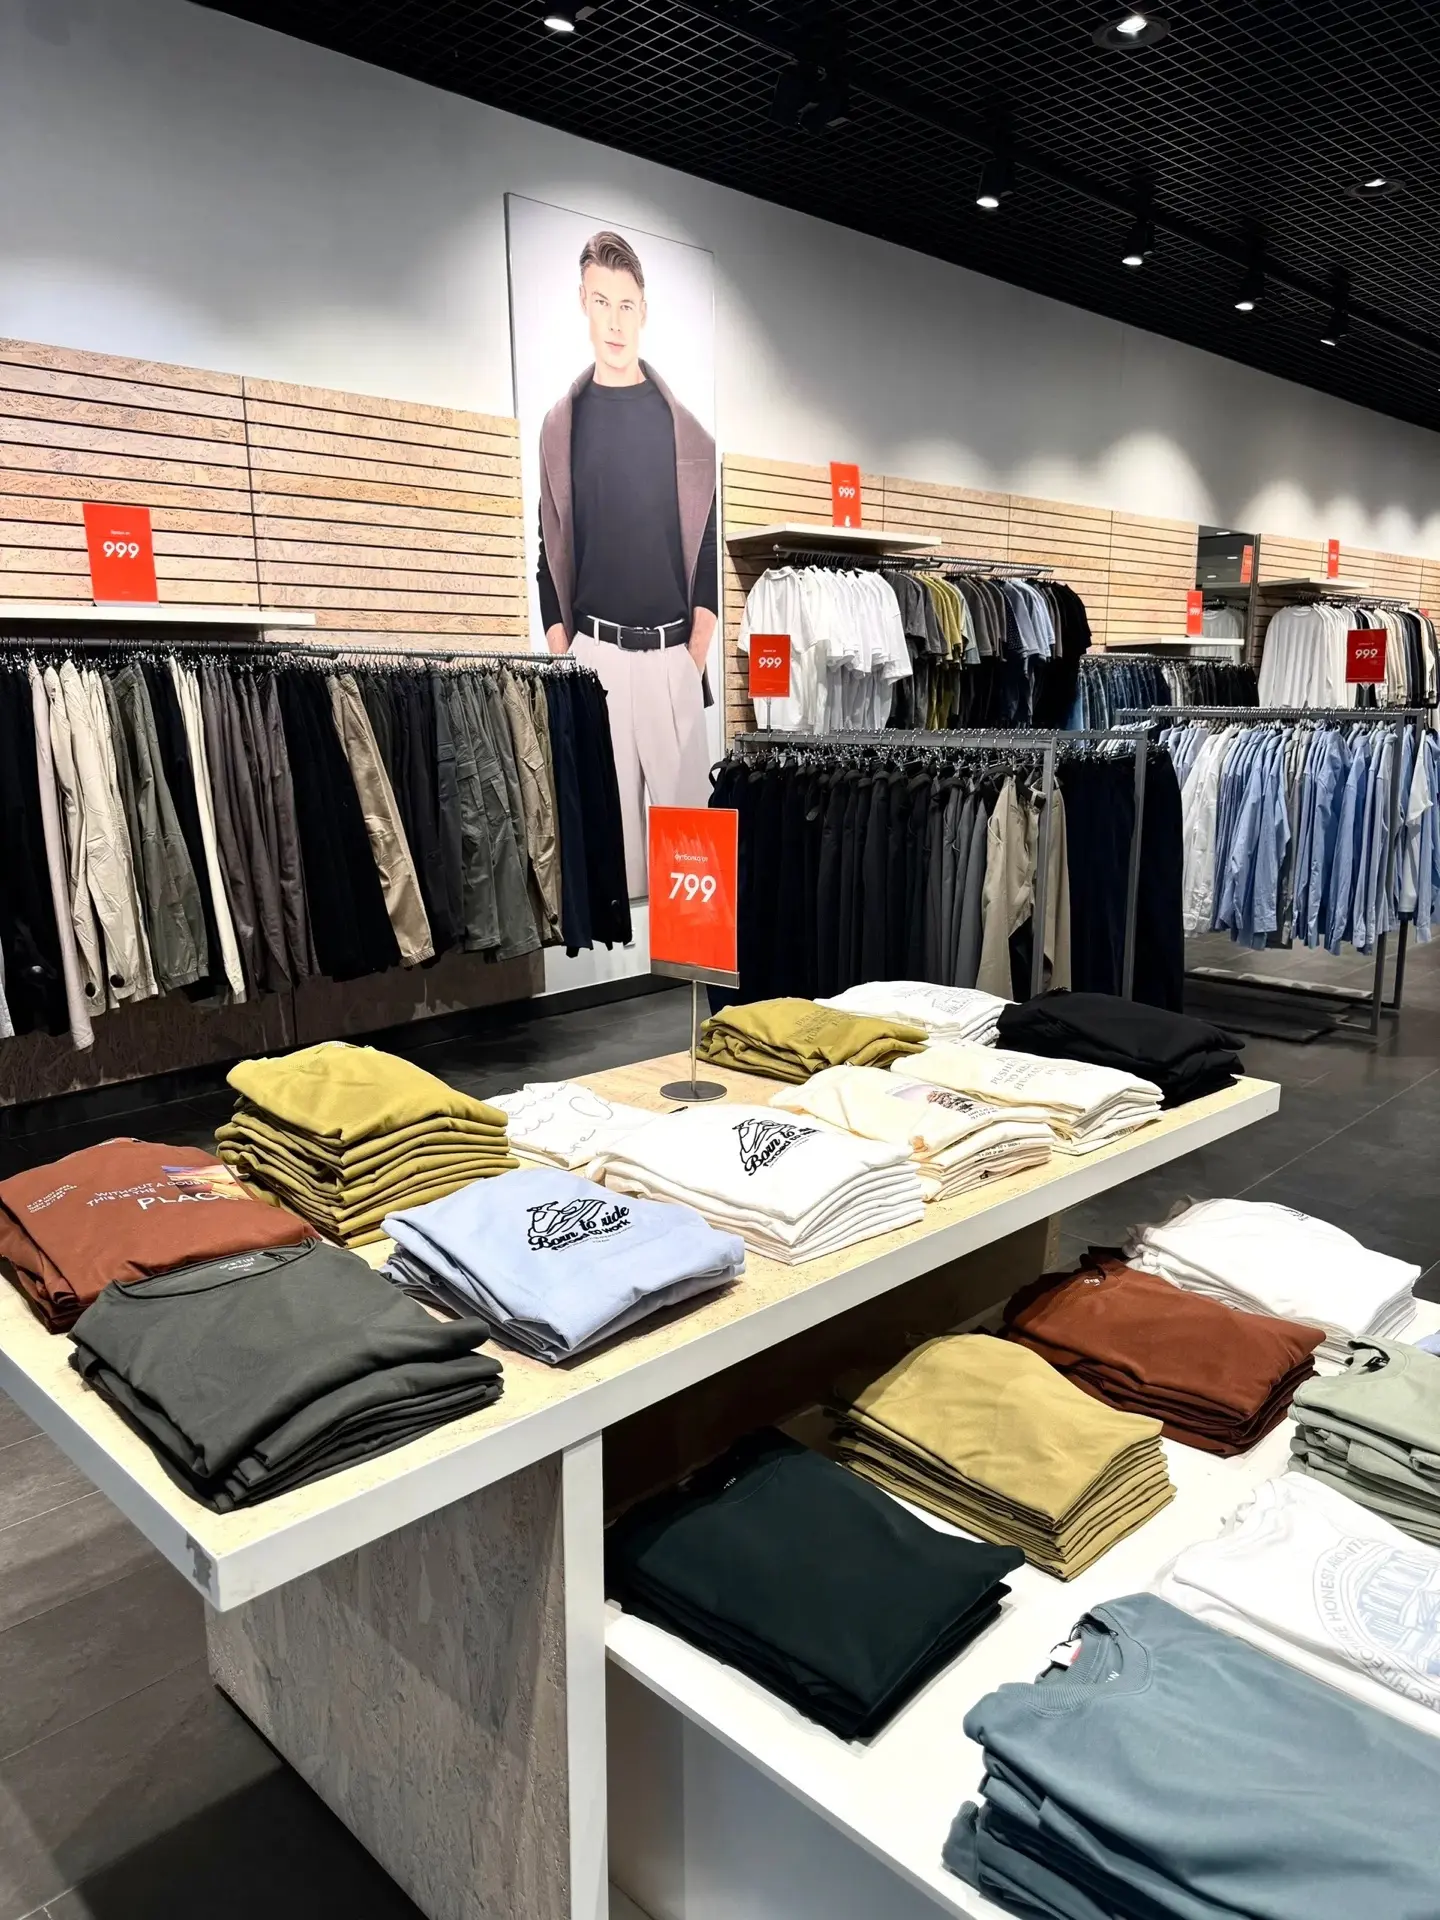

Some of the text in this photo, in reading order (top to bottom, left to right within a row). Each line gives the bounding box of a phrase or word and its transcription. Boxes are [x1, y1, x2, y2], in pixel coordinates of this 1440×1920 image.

[102, 540, 140, 559] 999
[758, 656, 783, 669] 999
[1355, 648, 1379, 660] 999
[668, 872, 717, 903] 799
[744, 1138, 781, 1177] Born
[86, 1188, 157, 1208] THIS IS THE
[95, 1183, 153, 1198] WITHOUT
[528, 1231, 579, 1251] Born
[580, 1219, 598, 1232] to
[601, 1205, 630, 1227] ride
[602, 1218, 632, 1234] work
[1320, 1568, 1342, 1622] HONEST
